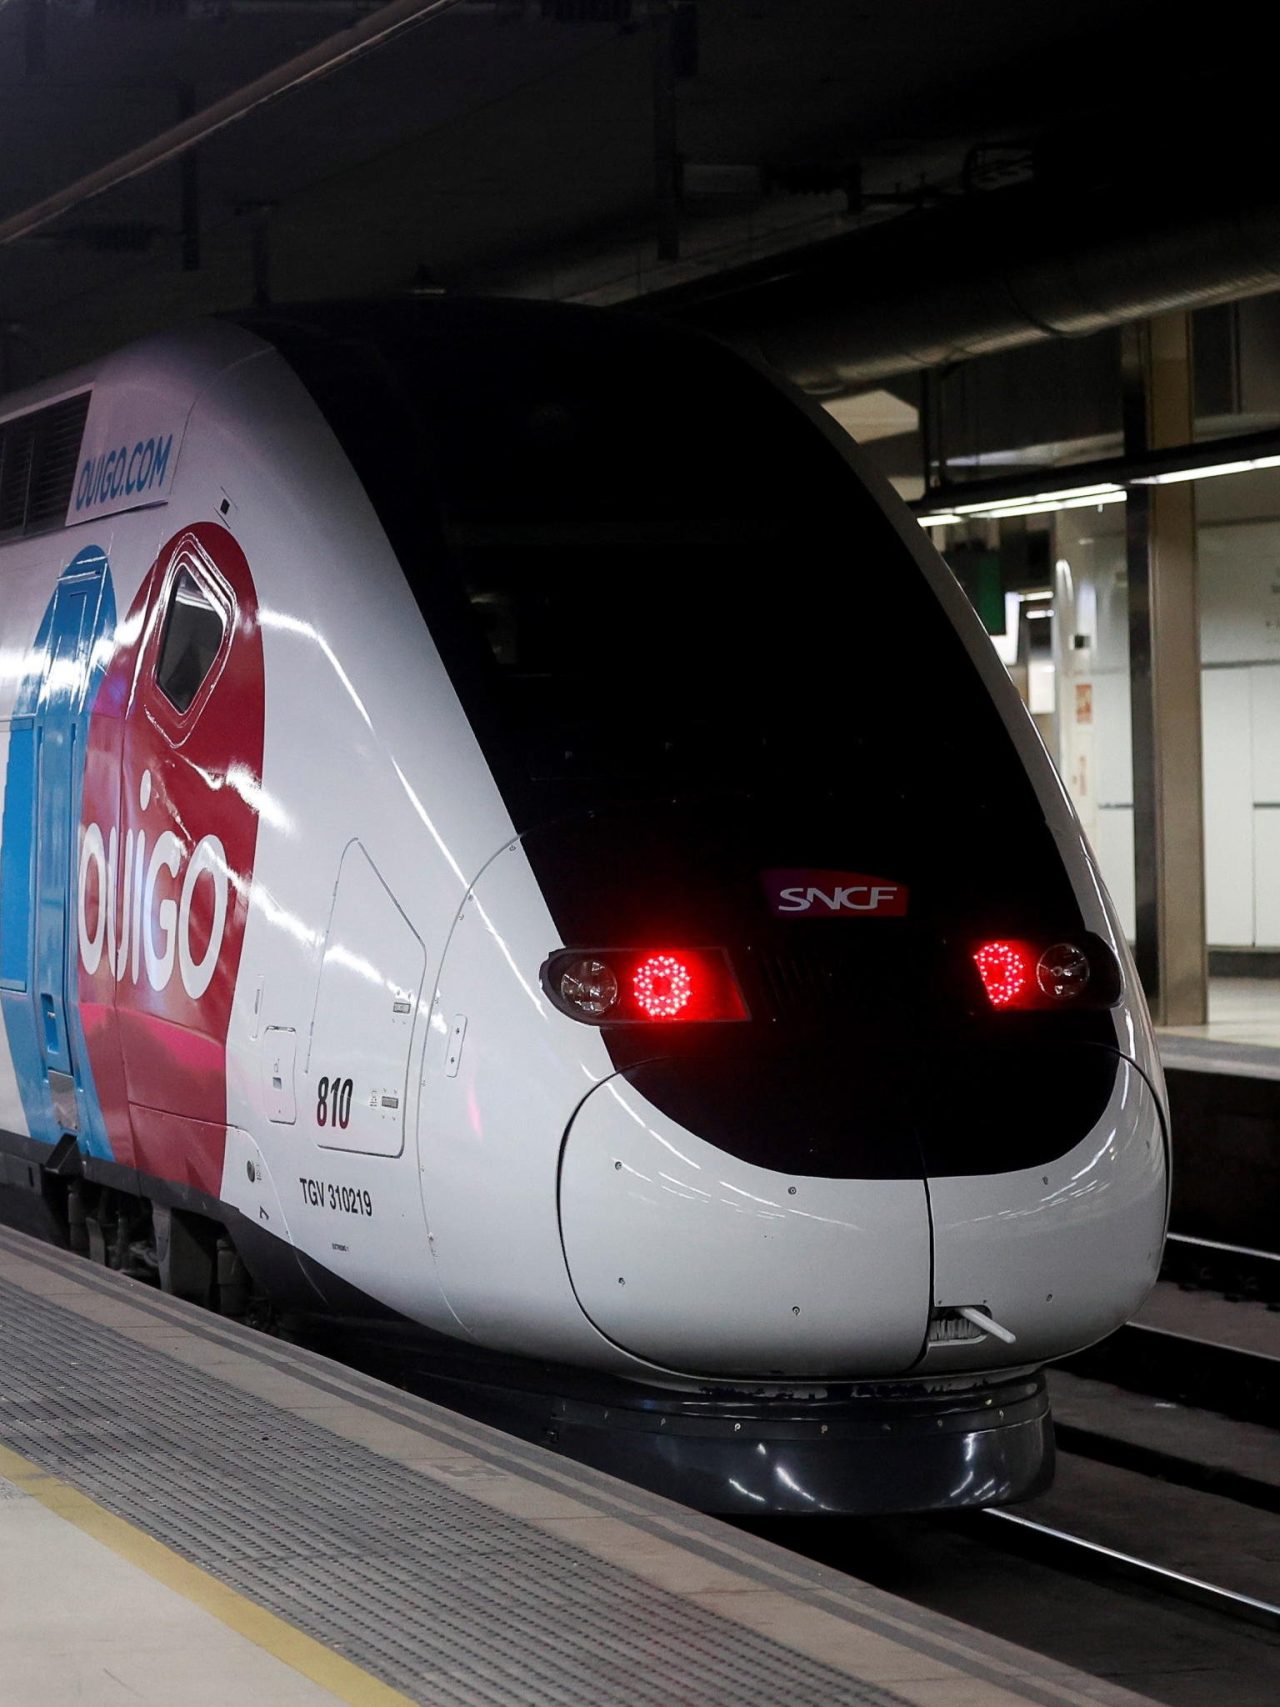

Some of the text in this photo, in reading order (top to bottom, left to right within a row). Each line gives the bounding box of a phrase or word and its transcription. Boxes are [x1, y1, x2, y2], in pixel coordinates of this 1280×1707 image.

[75, 434, 173, 511] OUIGO.COM
[78, 769, 229, 1000] OUIGO
[778, 886, 898, 912] SNCF
[316, 1076, 354, 1129] 810
[299, 1178, 373, 1217] TGV 310219
